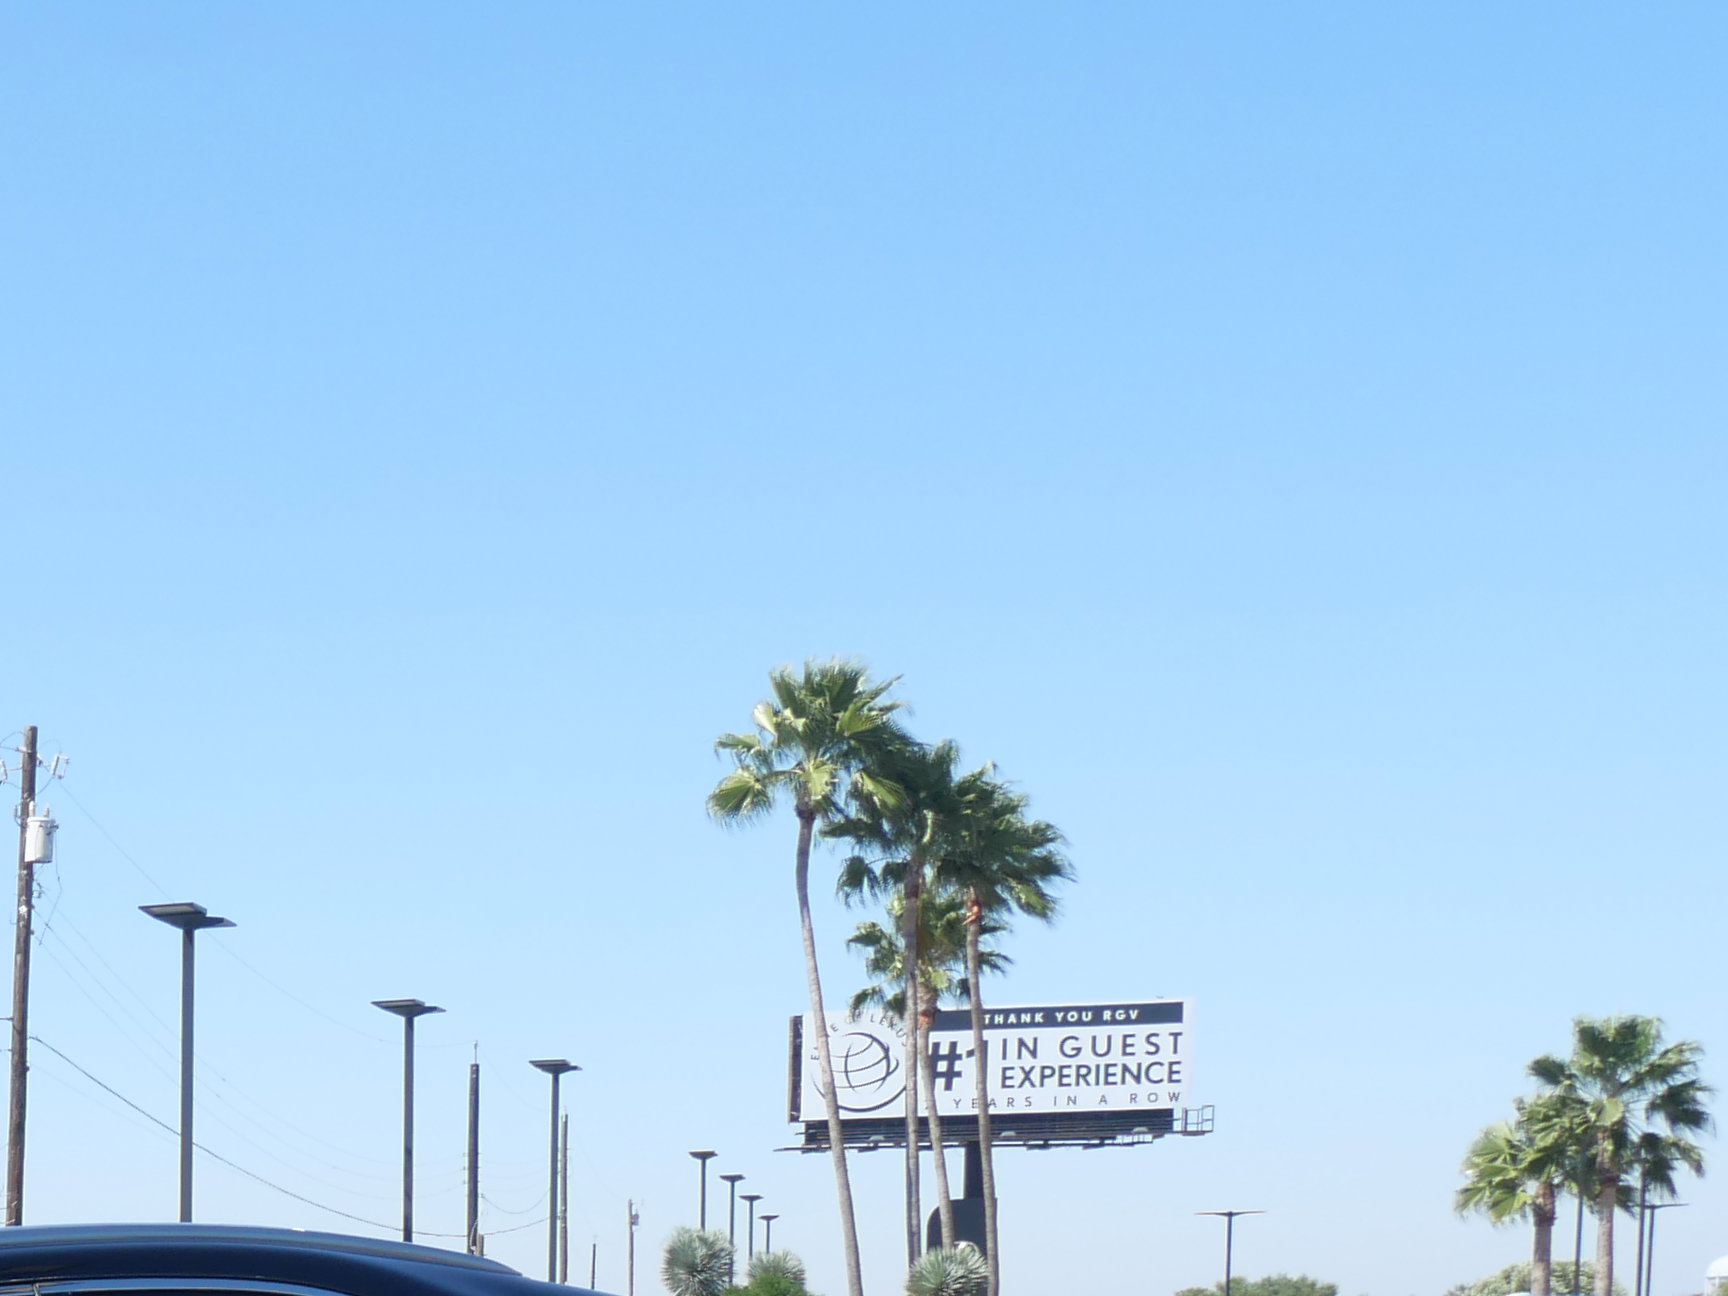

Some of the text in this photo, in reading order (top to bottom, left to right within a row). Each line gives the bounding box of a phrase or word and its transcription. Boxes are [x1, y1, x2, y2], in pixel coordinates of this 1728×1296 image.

[984, 1009, 1140, 1025] THANK YOU RGV
[1001, 1031, 1183, 1061] IN GUEST
[1000, 1061, 1182, 1089] EXPERIENCE
[953, 1091, 1181, 1109] YEARS IN A ROW
